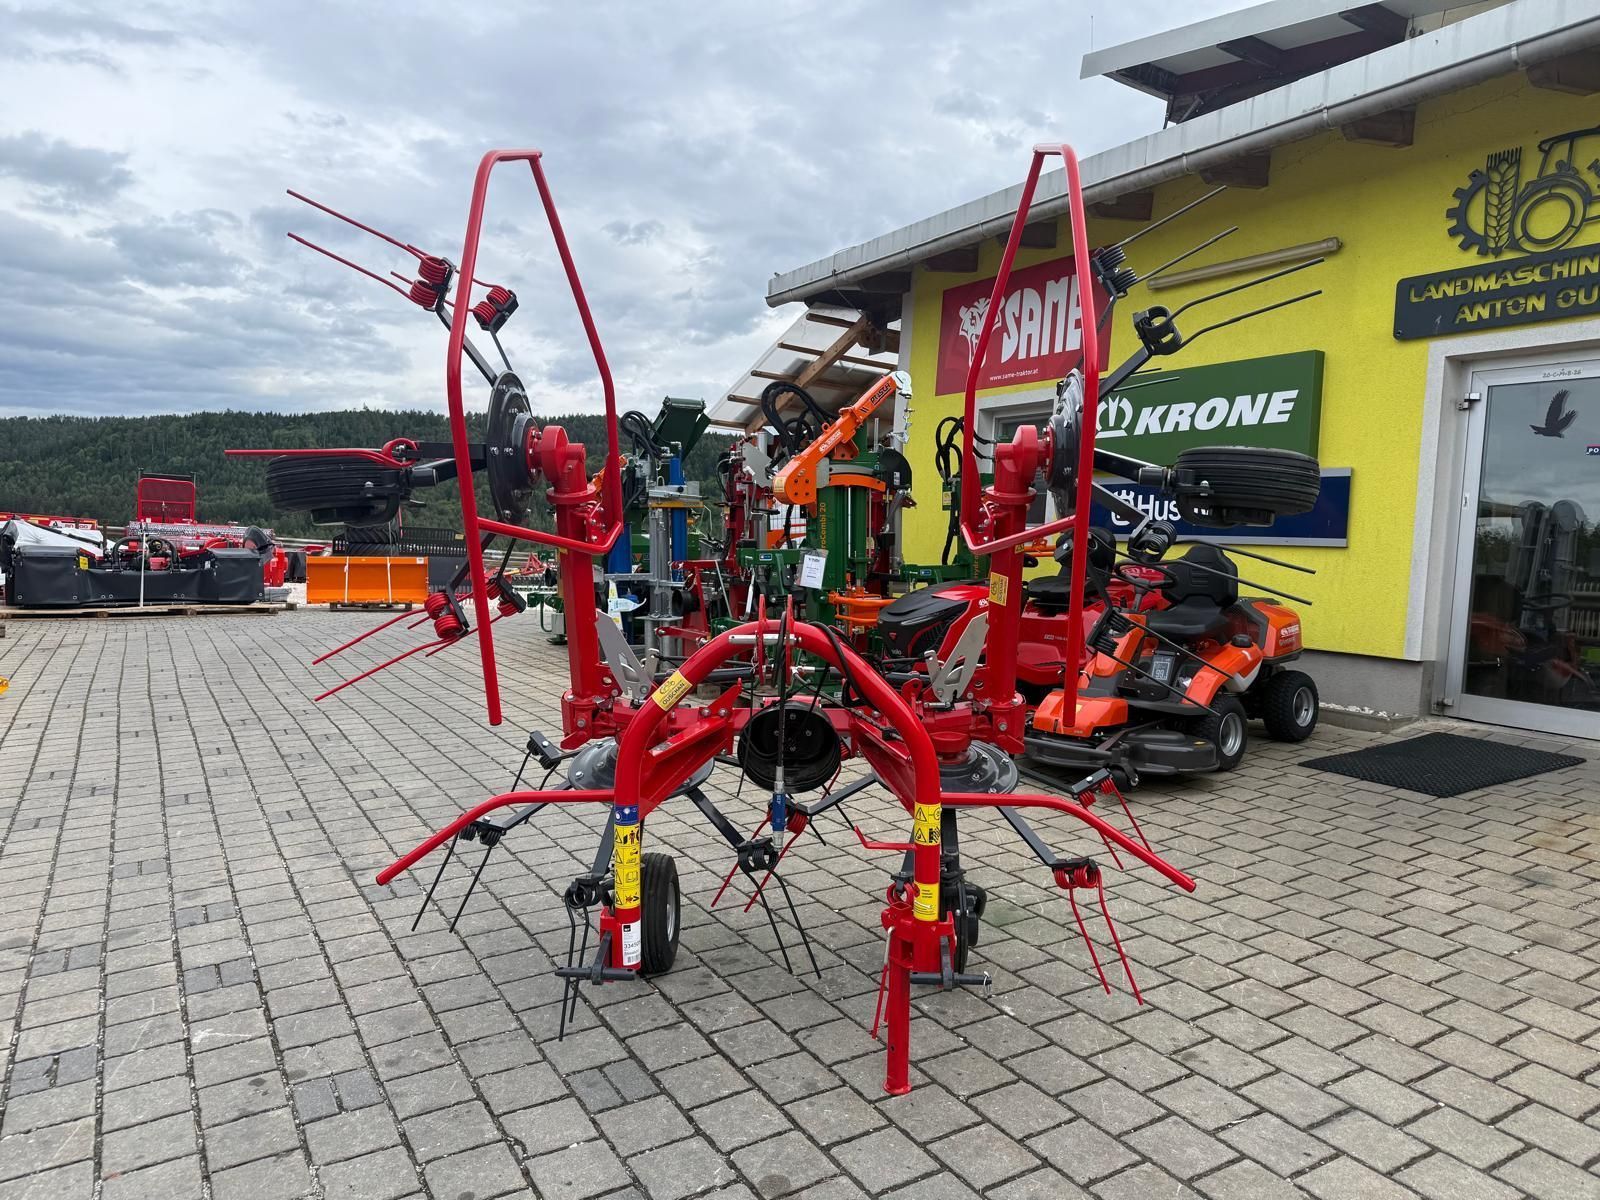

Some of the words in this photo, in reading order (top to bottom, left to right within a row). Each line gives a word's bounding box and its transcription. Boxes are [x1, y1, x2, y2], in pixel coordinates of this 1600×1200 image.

[1455, 291, 1546, 324] ANTON
[989, 368, 1039, 381] www.same-traktor.at
[1133, 389, 1299, 436] KRONE
